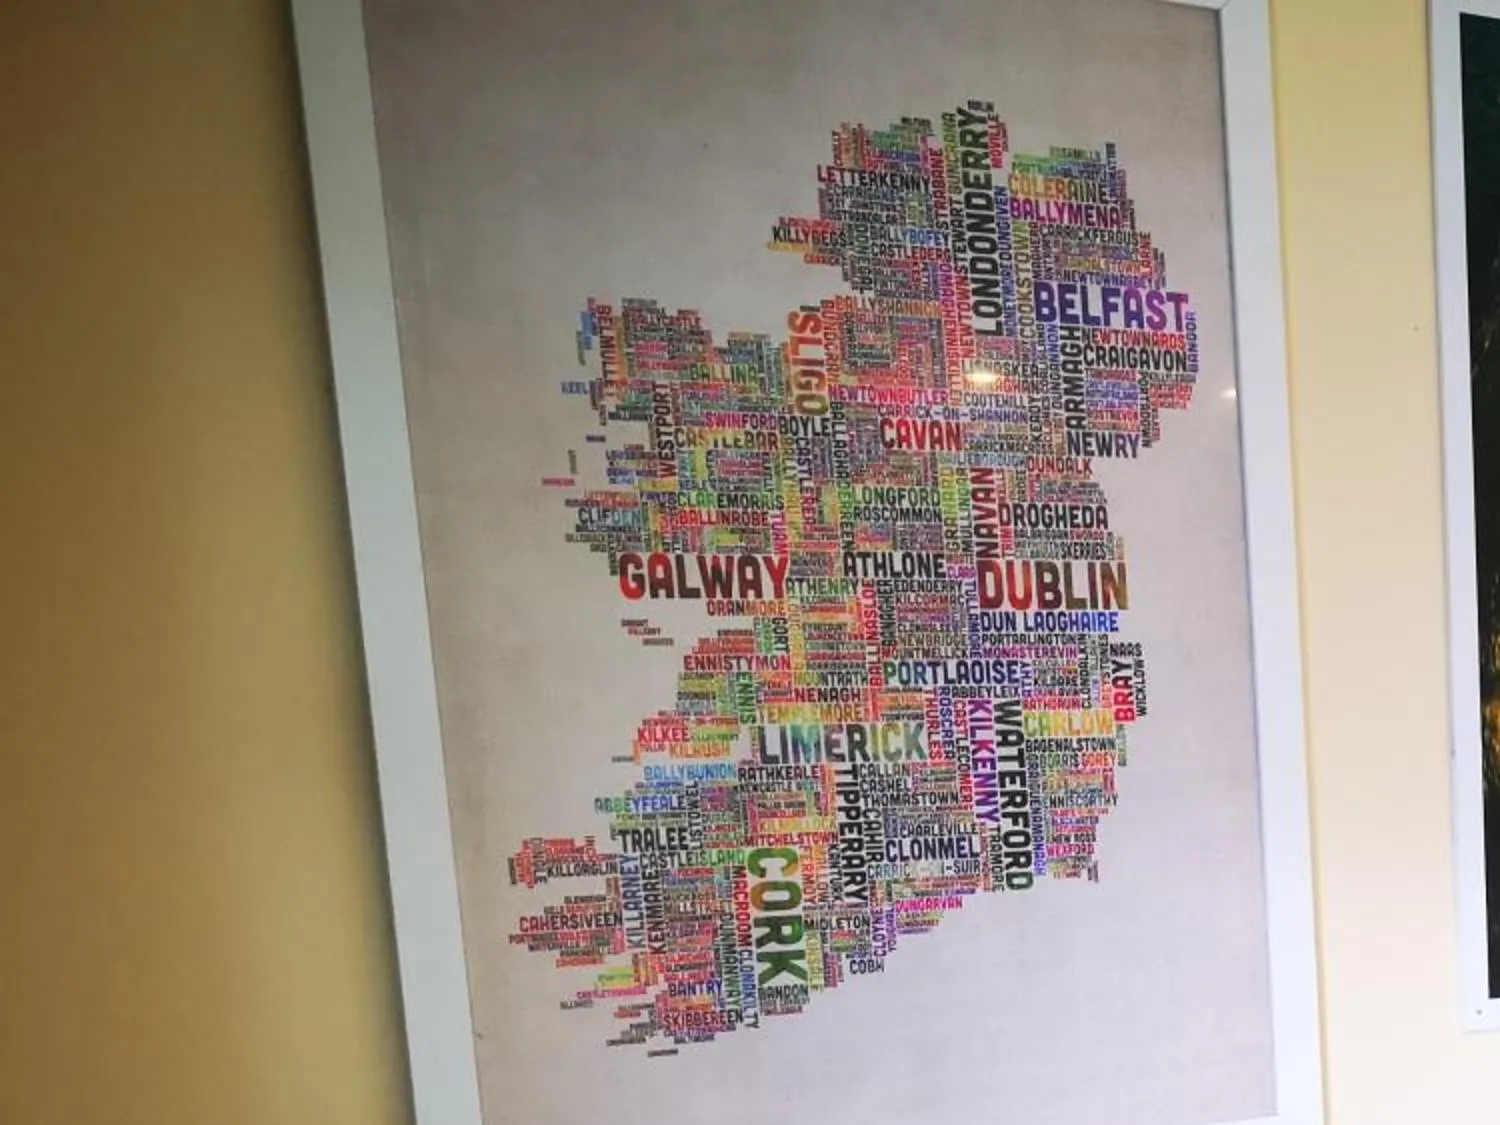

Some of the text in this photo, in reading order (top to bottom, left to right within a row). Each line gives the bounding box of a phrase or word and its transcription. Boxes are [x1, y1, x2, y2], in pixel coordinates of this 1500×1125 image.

[817, 164, 931, 191] LETTERKENNY
[930, 148, 949, 230] STRABANE
[1009, 173, 1109, 204] COLERAINE
[957, 106, 1003, 337] LONDONDERRY
[995, 186, 1011, 260] DUNGIVEN
[1010, 198, 1122, 229] BALLYMENA
[772, 225, 849, 247] KILLYBEGS
[870, 227, 949, 248] BALLYBOFEY
[1041, 224, 1139, 246] CARRICKFERGUS
[871, 243, 951, 263] CASTLEDERG
[949, 199, 976, 360] NEWTOWNSTEWART
[1012, 221, 1036, 338] COOKSTOWN
[1034, 281, 1189, 332] BELFAST
[1082, 327, 1185, 349] NEWTOWNARDS
[1185, 310, 1199, 373] BANGOR
[787, 311, 829, 415] SLIGO
[1047, 323, 1063, 410] DUNGANNON
[1083, 344, 1187, 372] CRAIGAVON
[1060, 325, 1086, 430] ARMAGH
[828, 385, 948, 405] NEWTOWNBUTLER
[652, 381, 677, 478] WESTPORT
[705, 413, 778, 431] SWINFORD
[778, 415, 831, 437] BOYLE
[1029, 396, 1042, 442] KEADY
[675, 427, 779, 450] CASTLEBAR
[880, 418, 962, 452] CAVAN
[1067, 431, 1140, 459] NEWRY
[1027, 455, 1093, 475] DUNDALK
[677, 492, 784, 511] CLAREMORRIS
[852, 485, 940, 507] LONGFORD
[941, 467, 958, 551] GRANARD
[956, 467, 974, 552] MULLINGAR
[678, 508, 769, 527] BALLINROBE
[853, 506, 942, 523] ROSCOMMON
[971, 467, 998, 558] NAVAN
[998, 502, 1109, 529] DROGHEDA
[772, 511, 787, 555] TUAM
[619, 552, 789, 600] GALWAY
[842, 551, 947, 579] ATHLONE
[786, 577, 859, 596] ATHENRY
[894, 579, 963, 594] EDENDERRY
[976, 559, 1129, 611] DUBLIN
[707, 600, 786, 618] ORANMORE
[965, 581, 982, 660] TULLAMORE
[981, 612, 1017, 632] DUN
[1024, 611, 1119, 633] LAOGHAIRE
[772, 617, 788, 653] GORT
[863, 579, 882, 687] BALLINASLOE
[981, 633, 1079, 646] PORTARLINGTON
[683, 655, 791, 671] ENNISTYMON
[1110, 642, 1143, 658] NAAS
[885, 660, 1020, 685] PORTLAOISE
[736, 671, 756, 724] ENNIS
[793, 687, 861, 703] NENAGH
[952, 686, 1021, 699] ABBEYLEIX
[1112, 659, 1136, 722] BRAY
[1133, 659, 1147, 717] WICKLOW
[637, 728, 690, 743] KILKEE
[925, 687, 942, 760] THURLES
[940, 687, 955, 759] ROSCREA
[1023, 709, 1114, 736] CARLOW
[760, 723, 926, 764] LIMERICK
[1026, 736, 1116, 753] BAGENALSTOWN
[644, 763, 737, 781] BALLYBUNION
[738, 766, 820, 781] RATHKEALE
[968, 700, 1000, 827] KILKENNY
[860, 778, 911, 793] CASHEL
[860, 791, 960, 807] THOMASTOWN
[994, 700, 1034, 891] WATERFORD
[618, 828, 689, 852] TRALEE
[835, 764, 868, 900] TIPPERARY
[863, 808, 884, 862] CAHIR
[900, 822, 979, 839] CHARLEVILLE
[640, 848, 746, 870] CASTLEISLAND
[885, 837, 981, 862] CLONMEL
[988, 827, 1004, 892] TRAMORE
[620, 854, 646, 949] KILLARNEY
[641, 868, 667, 954] KENMARE
[732, 865, 752, 947] MACROOM
[519, 911, 623, 932] CAHERSIVEEN
[747, 847, 810, 985] CORK
[804, 914, 871, 931] MIDLETON
[850, 958, 885, 975] COBH
[668, 980, 723, 998] BANTRY
[740, 949, 760, 1029] CLONAKILTY
[664, 1009, 743, 1029] SKIBBEREEN
